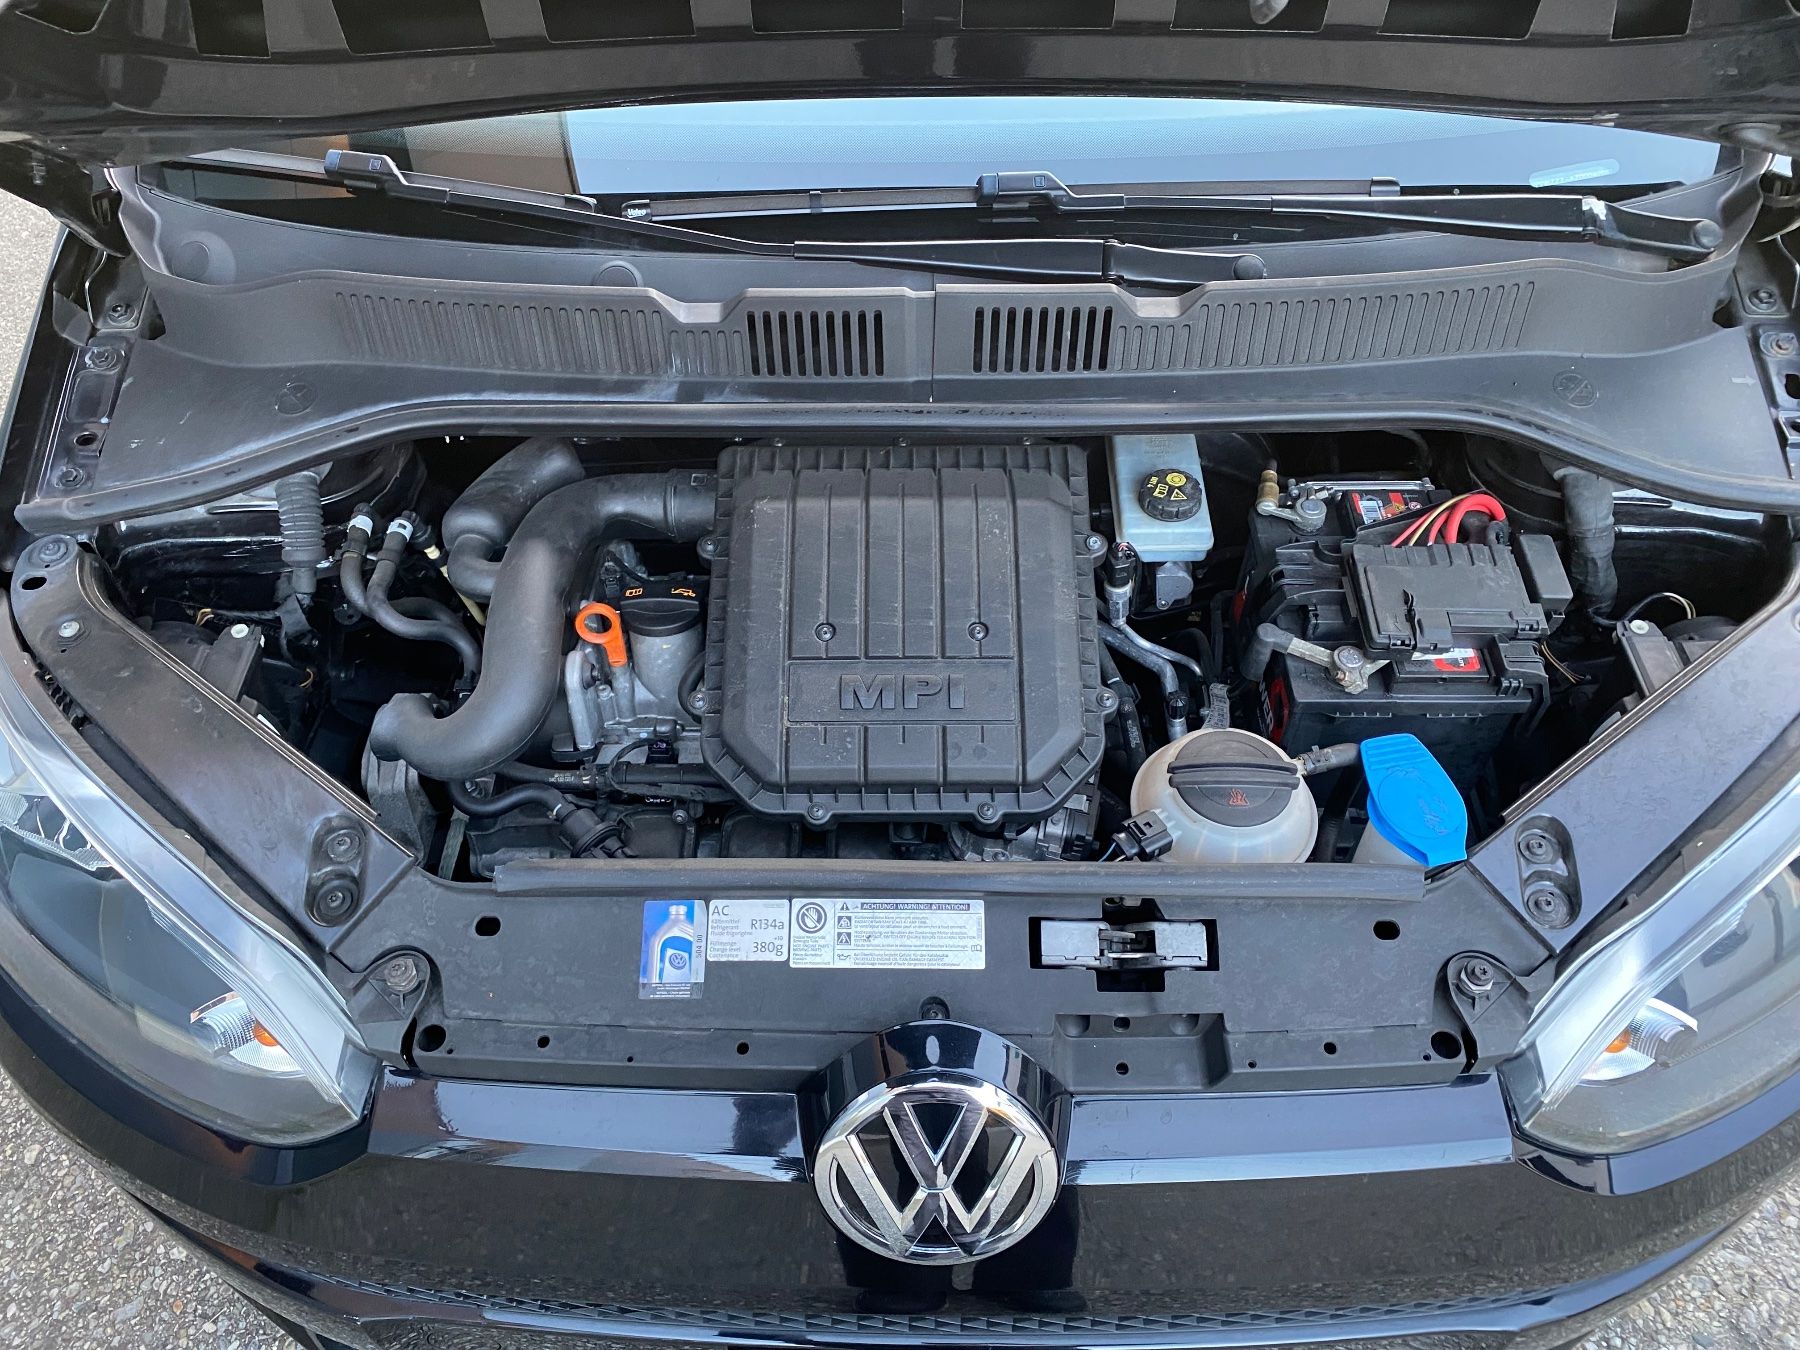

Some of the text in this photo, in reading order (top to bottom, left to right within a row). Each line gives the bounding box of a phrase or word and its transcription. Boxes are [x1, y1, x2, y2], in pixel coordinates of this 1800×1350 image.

[839, 674, 965, 710] MPI
[711, 905, 730, 916] AC
[931, 903, 968, 911] ATTENTION!
[750, 918, 785, 930] R134a
